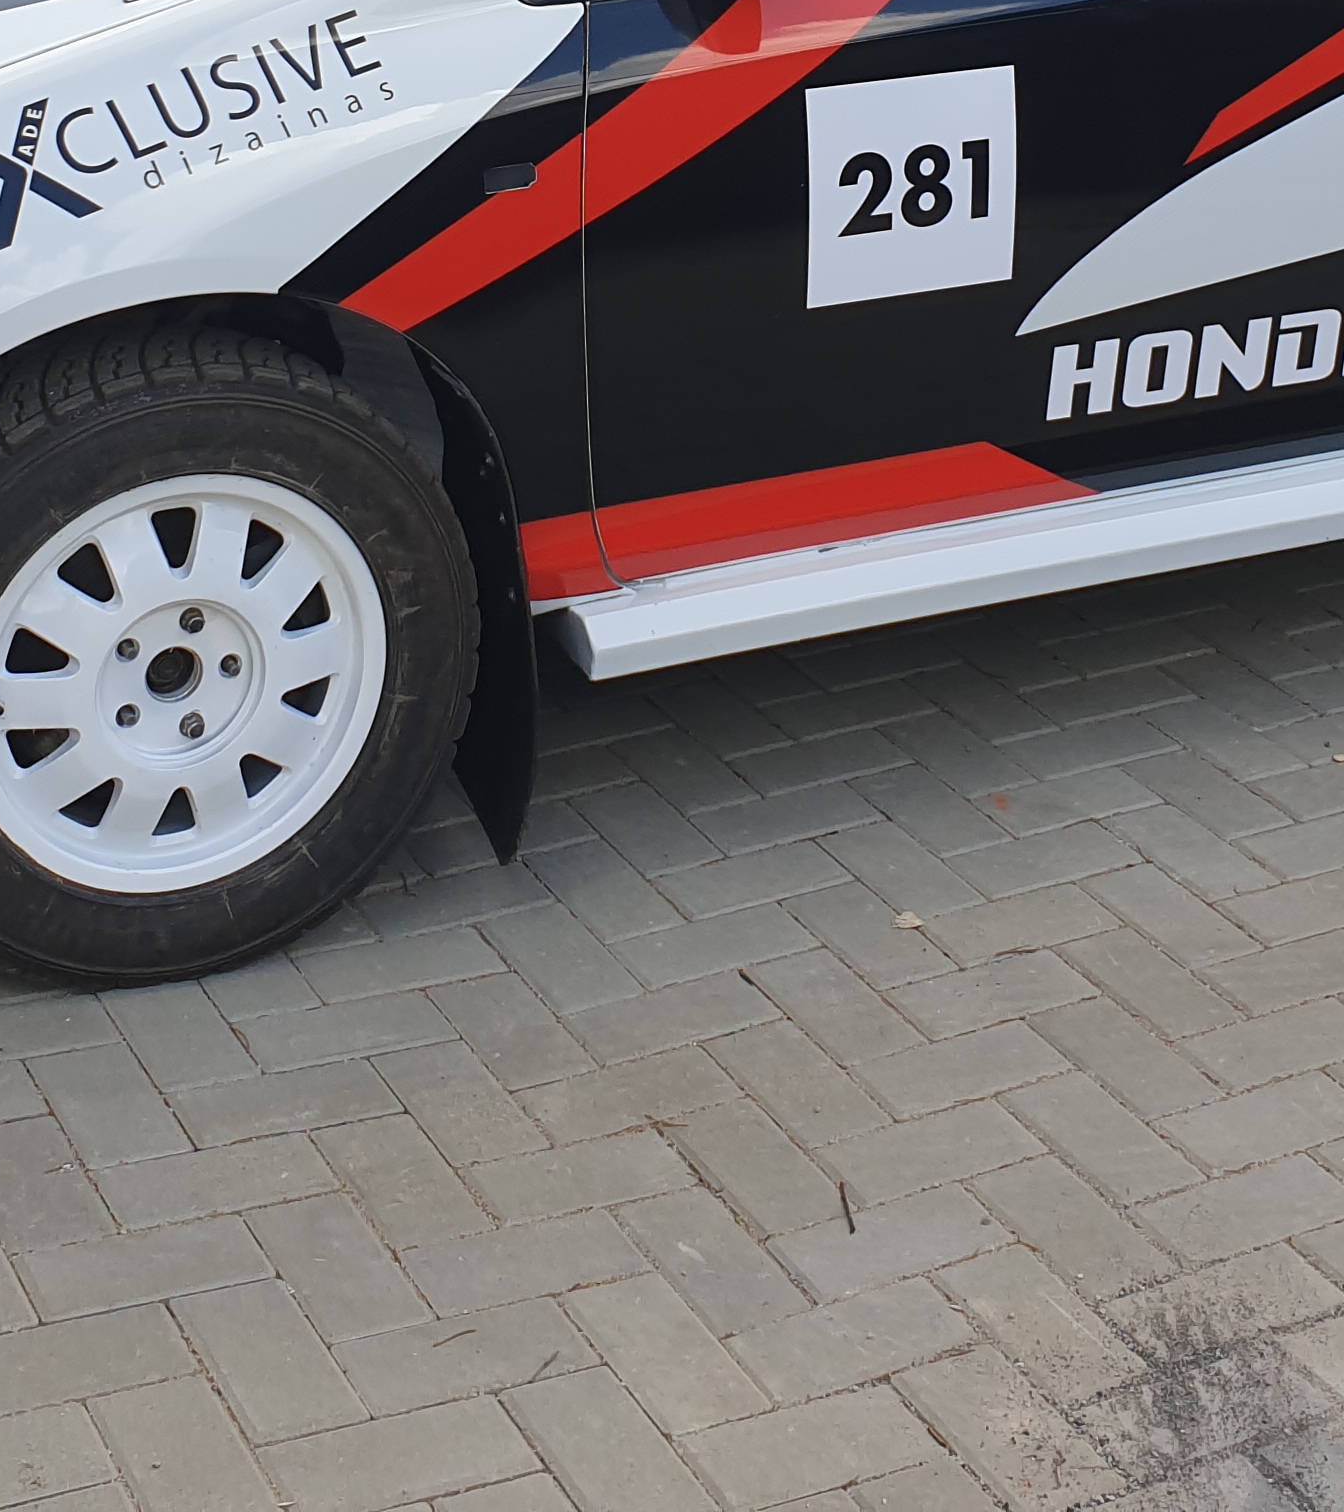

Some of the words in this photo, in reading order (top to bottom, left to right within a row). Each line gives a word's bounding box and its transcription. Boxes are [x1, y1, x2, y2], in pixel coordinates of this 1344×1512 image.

[18, 104, 47, 160] ADE
[142, 78, 395, 190] dizainas
[837, 138, 990, 238] 281
